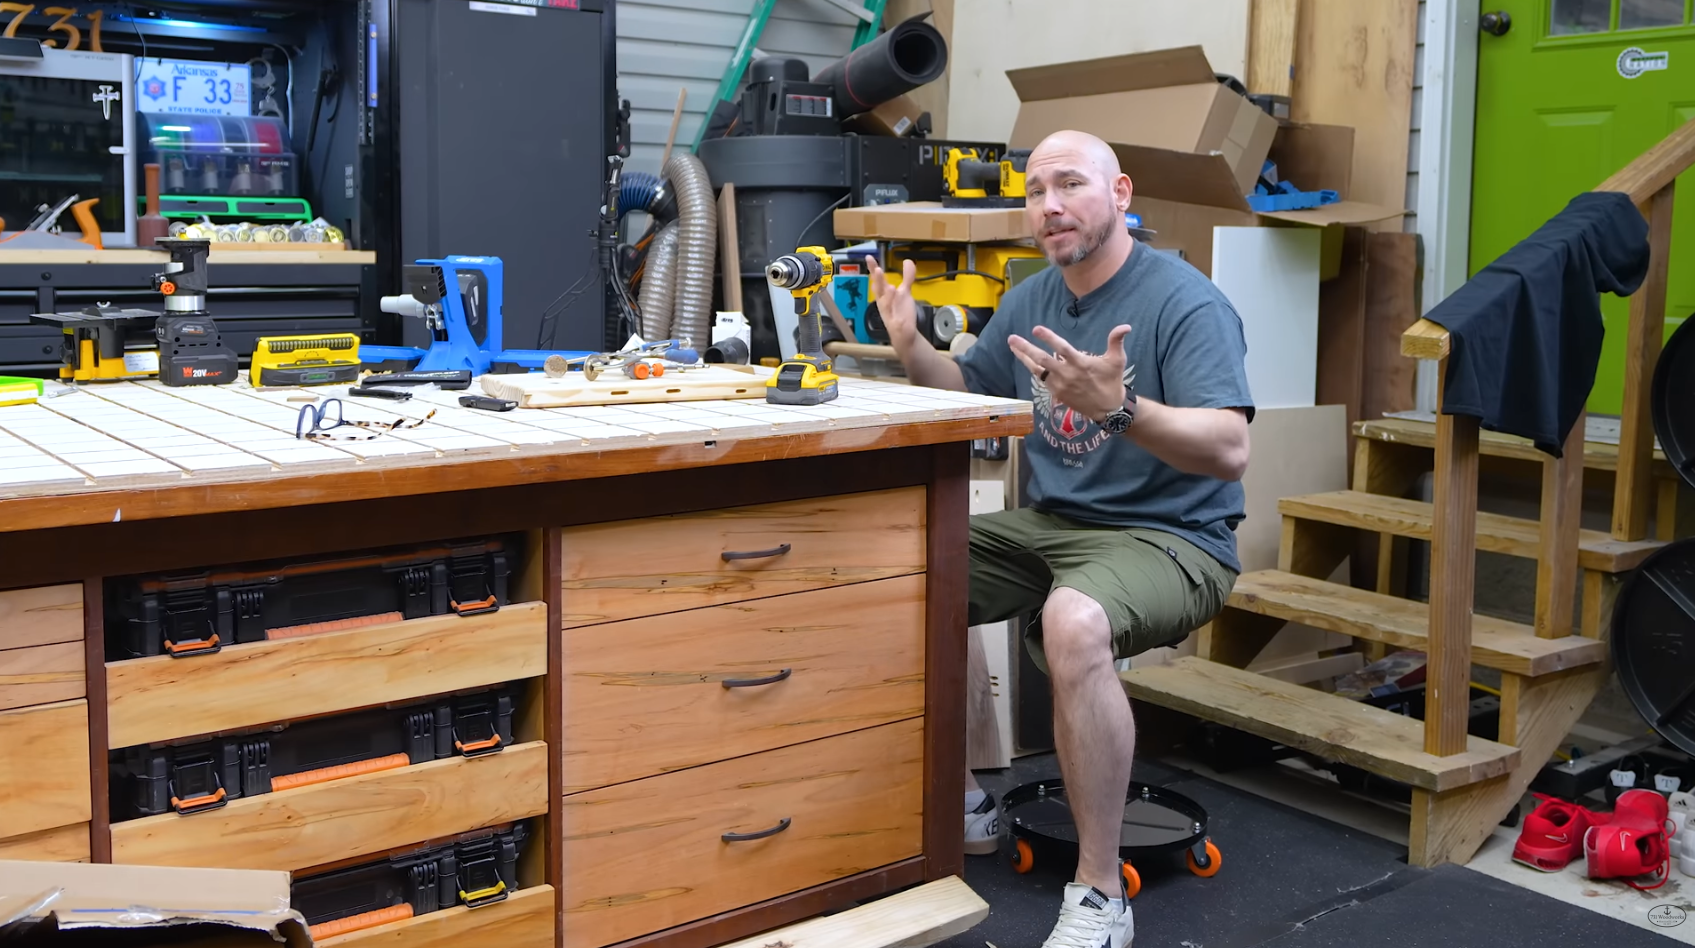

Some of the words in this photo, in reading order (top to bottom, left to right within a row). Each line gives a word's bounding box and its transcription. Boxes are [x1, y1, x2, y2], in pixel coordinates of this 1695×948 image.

[0, 2, 104, 52] 731
[171, 64, 218, 77] Arkansas
[173, 76, 187, 102] F
[204, 78, 232, 105] 33
[168, 106, 193, 114] STATE
[194, 107, 222, 115] POLICE
[193, 368, 207, 378] 20V
[1039, 422, 1058, 448] AND
[1060, 441, 1084, 454] THE
[1085, 429, 1110, 452] LIFE
[1661, 778, 1673, 789] T
